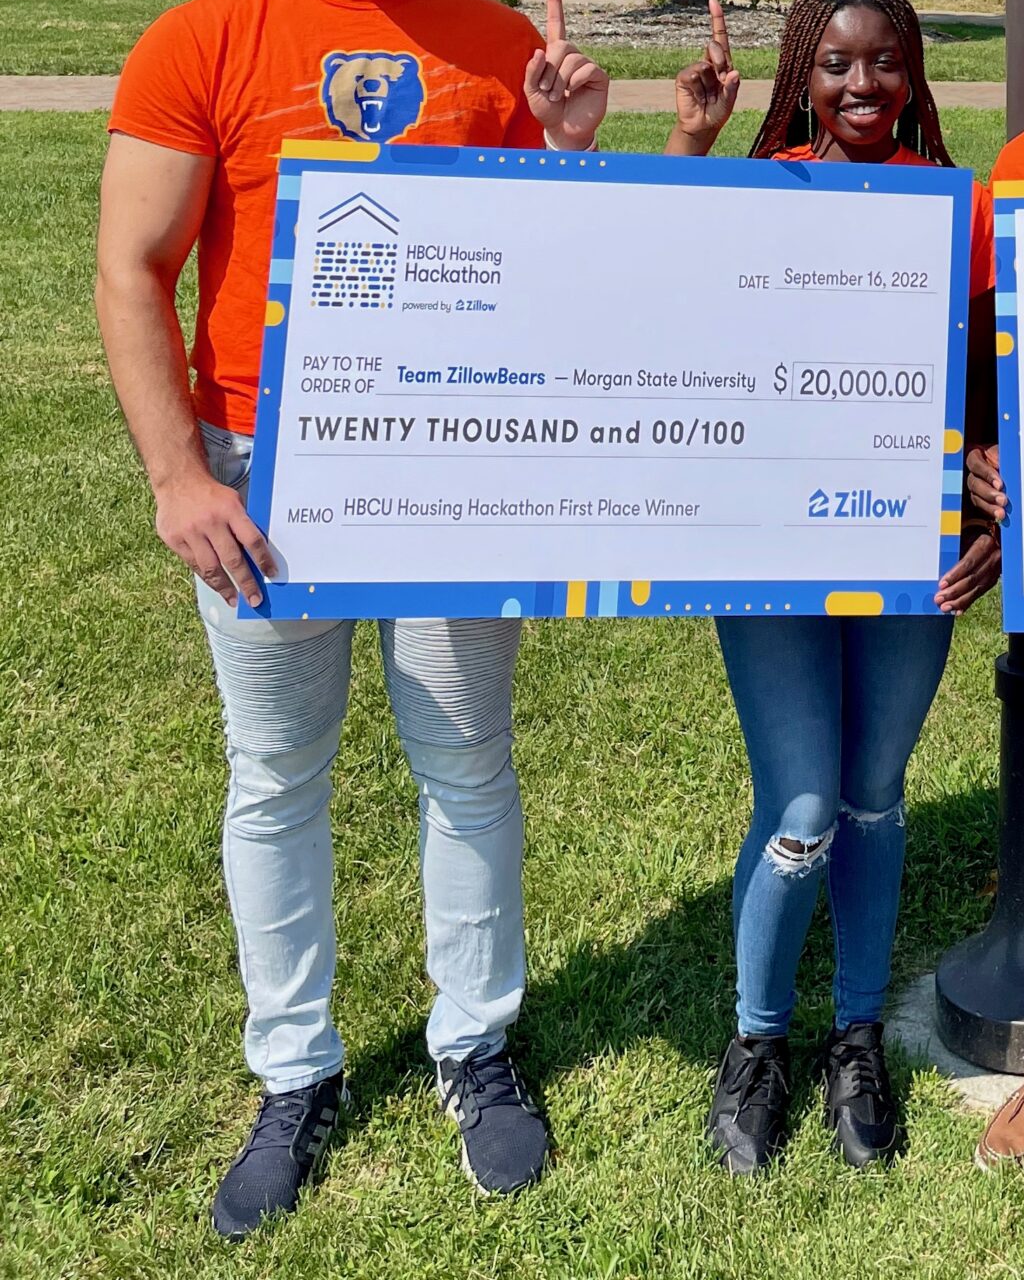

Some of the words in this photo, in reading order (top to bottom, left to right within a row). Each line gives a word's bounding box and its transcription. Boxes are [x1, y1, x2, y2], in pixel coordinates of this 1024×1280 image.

[406, 245, 446, 260] HBCU
[449, 246, 502, 265] Housing
[404, 263, 500, 284] Hackathon
[739, 275, 770, 289] DATE
[784, 268, 862, 288] September
[867, 272, 886, 290] 16,
[892, 272, 928, 288] 2022
[402, 300, 438, 312] powered
[440, 301, 451, 313] by
[466, 300, 496, 312] Zillow
[303, 356, 328, 370] PAY
[333, 356, 352, 370] TO
[356, 357, 382, 372] THE
[301, 378, 350, 392] ORDER
[354, 379, 374, 393] OF
[397, 366, 441, 383] Team
[447, 366, 546, 385] ZillowBears
[573, 369, 632, 390] Morgan
[637, 370, 677, 388] State
[682, 371, 756, 392] University
[774, 362, 787, 394] $
[800, 369, 926, 400] 20,000.00
[298, 416, 416, 441] TWENTY
[426, 418, 579, 443] THOUSAND
[590, 420, 640, 444] and
[652, 418, 745, 446] 00/100
[874, 435, 930, 449] DOLLARS
[288, 508, 334, 523] MEMO
[344, 498, 393, 516] HBCU
[398, 498, 462, 520] Housing
[468, 498, 554, 516] Hackathon
[559, 499, 592, 516] First
[598, 499, 640, 516] Place
[646, 500, 700, 516] Winner
[834, 490, 906, 518] Zillow
